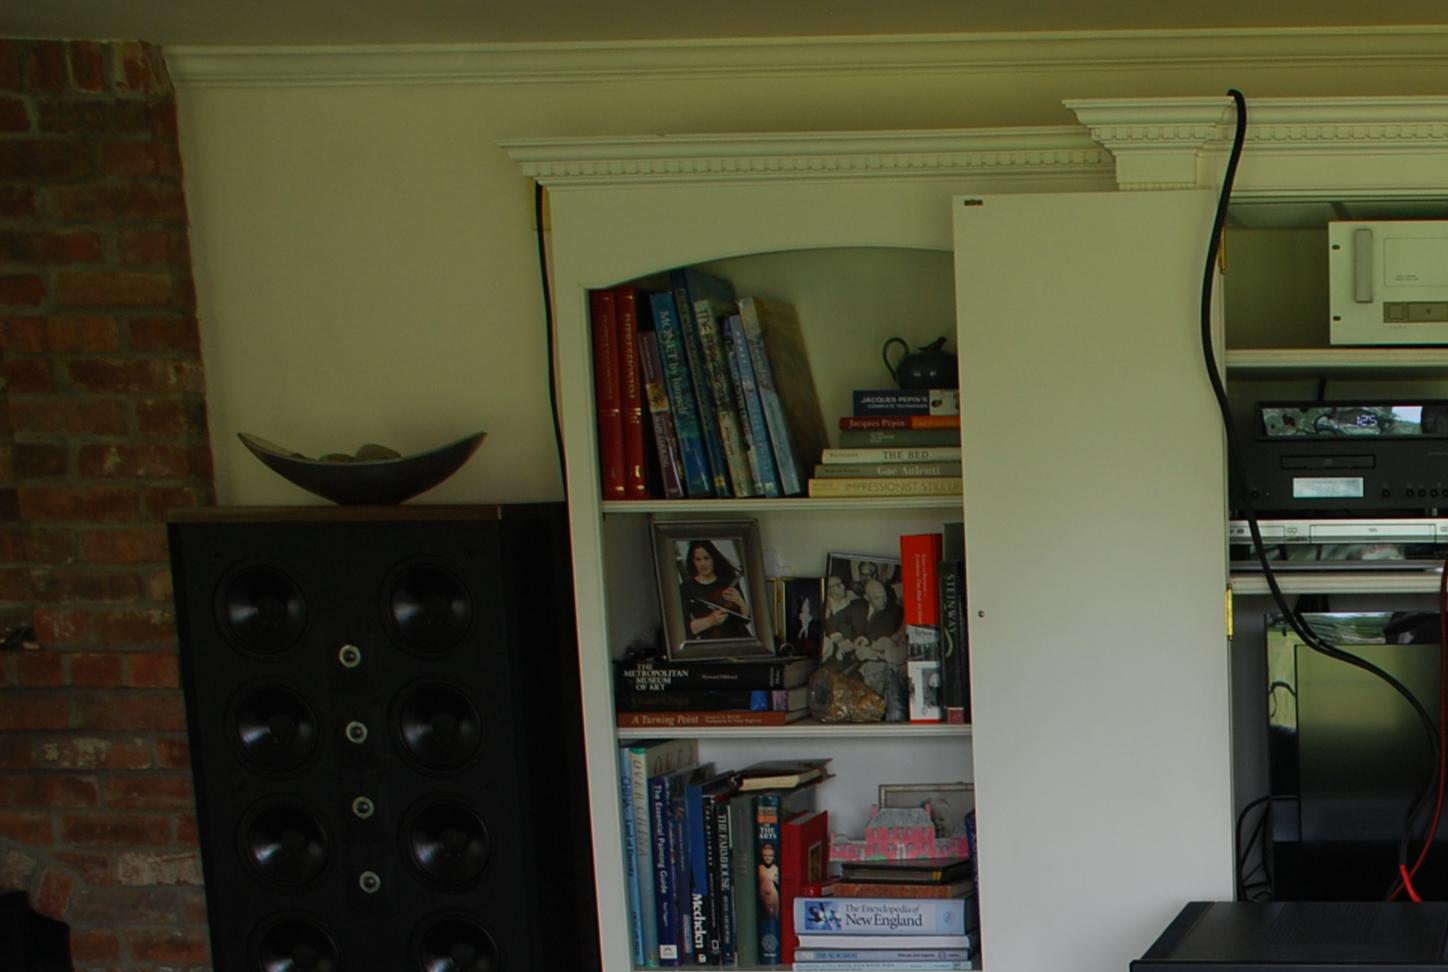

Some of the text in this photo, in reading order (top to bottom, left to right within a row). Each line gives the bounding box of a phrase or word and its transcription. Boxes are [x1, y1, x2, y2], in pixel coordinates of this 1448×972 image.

[658, 311, 678, 360] MONET
[672, 377, 689, 416] himself
[861, 396, 897, 404] JACQUES
[883, 451, 929, 460] THE BED
[945, 573, 957, 634] STEINWAY
[623, 670, 690, 678] METROPOLITAN
[636, 677, 672, 685] MUSEUM
[632, 715, 640, 724] A
[641, 715, 674, 726] Turning
[677, 715, 700, 725] Point
[718, 814, 727, 832] THE
[653, 784, 669, 895] The Essential Painting Guide
[845, 904, 920, 916] The Encyclopedia of
[692, 893, 707, 949] Mechelen
[846, 913, 923, 929] New England
